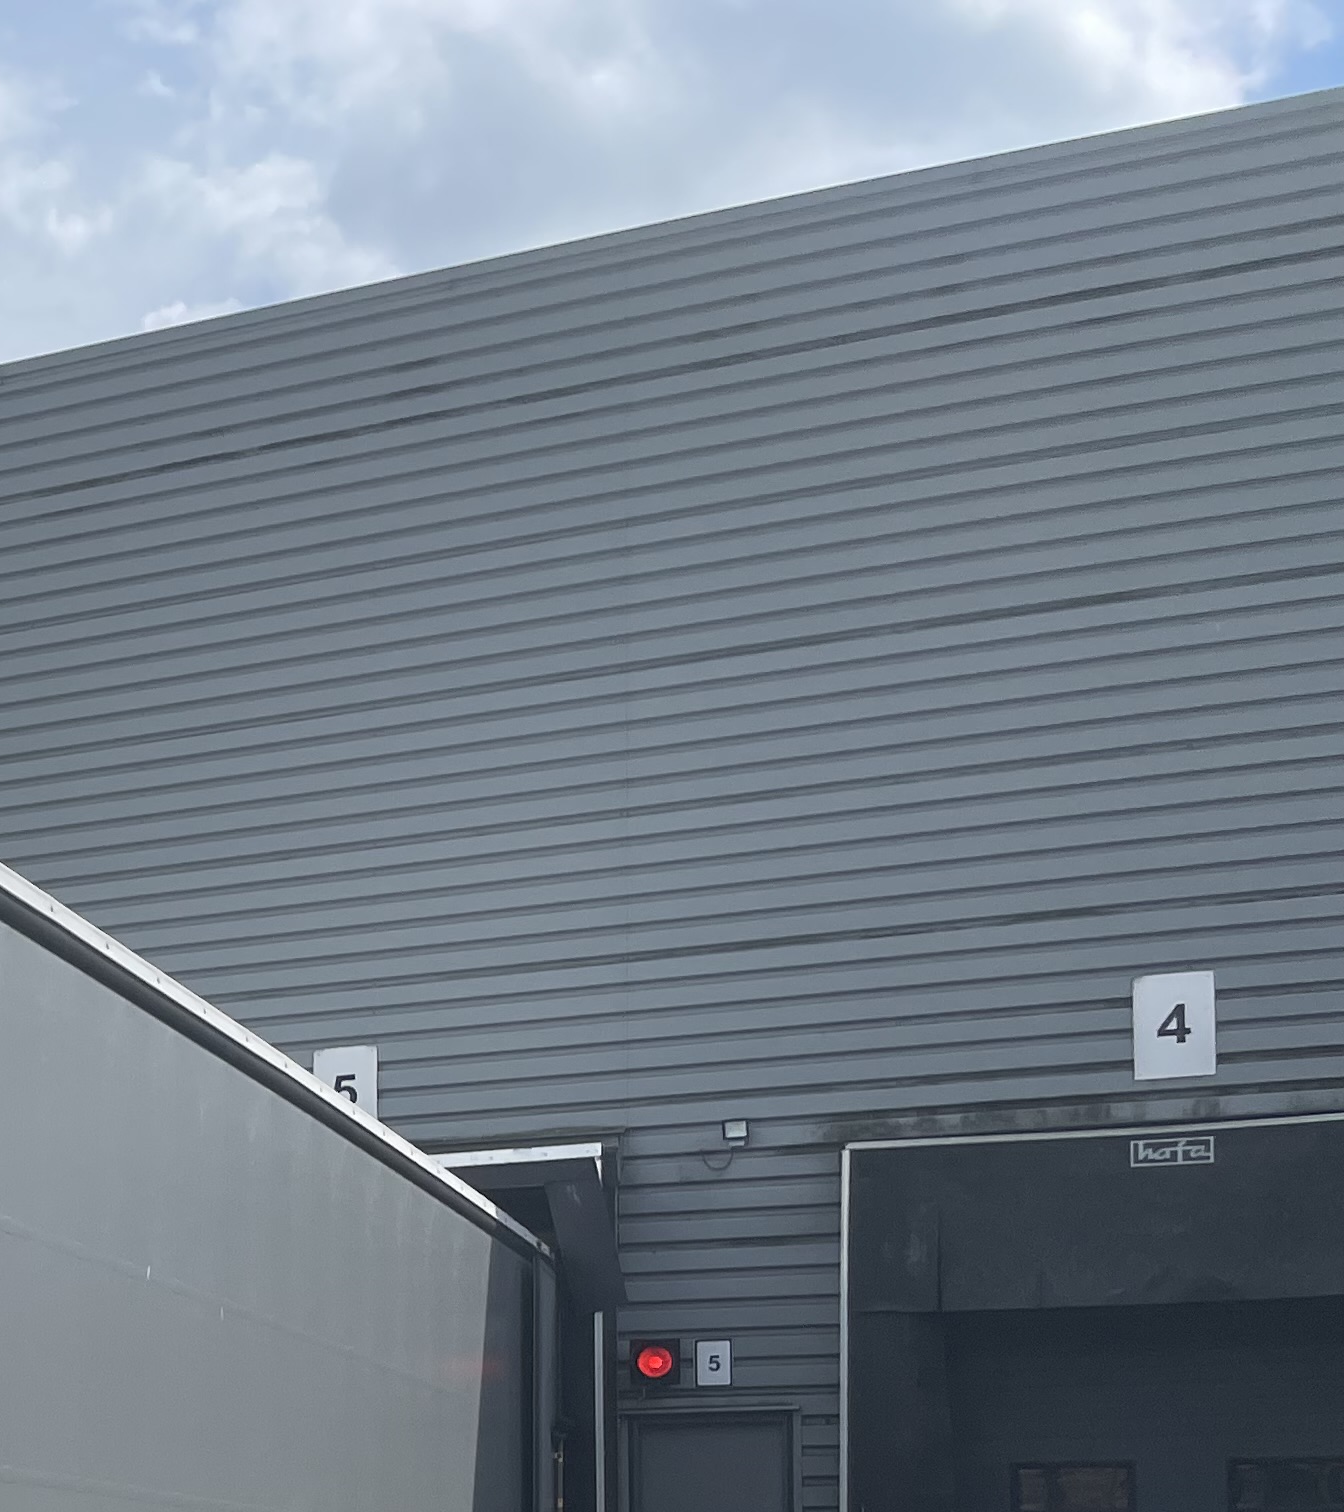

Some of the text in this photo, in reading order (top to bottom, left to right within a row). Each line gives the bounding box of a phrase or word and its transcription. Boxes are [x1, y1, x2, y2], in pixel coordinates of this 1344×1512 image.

[1157, 1003, 1192, 1043] 4
[334, 1074, 358, 1104] 5
[708, 1354, 721, 1372] 5
